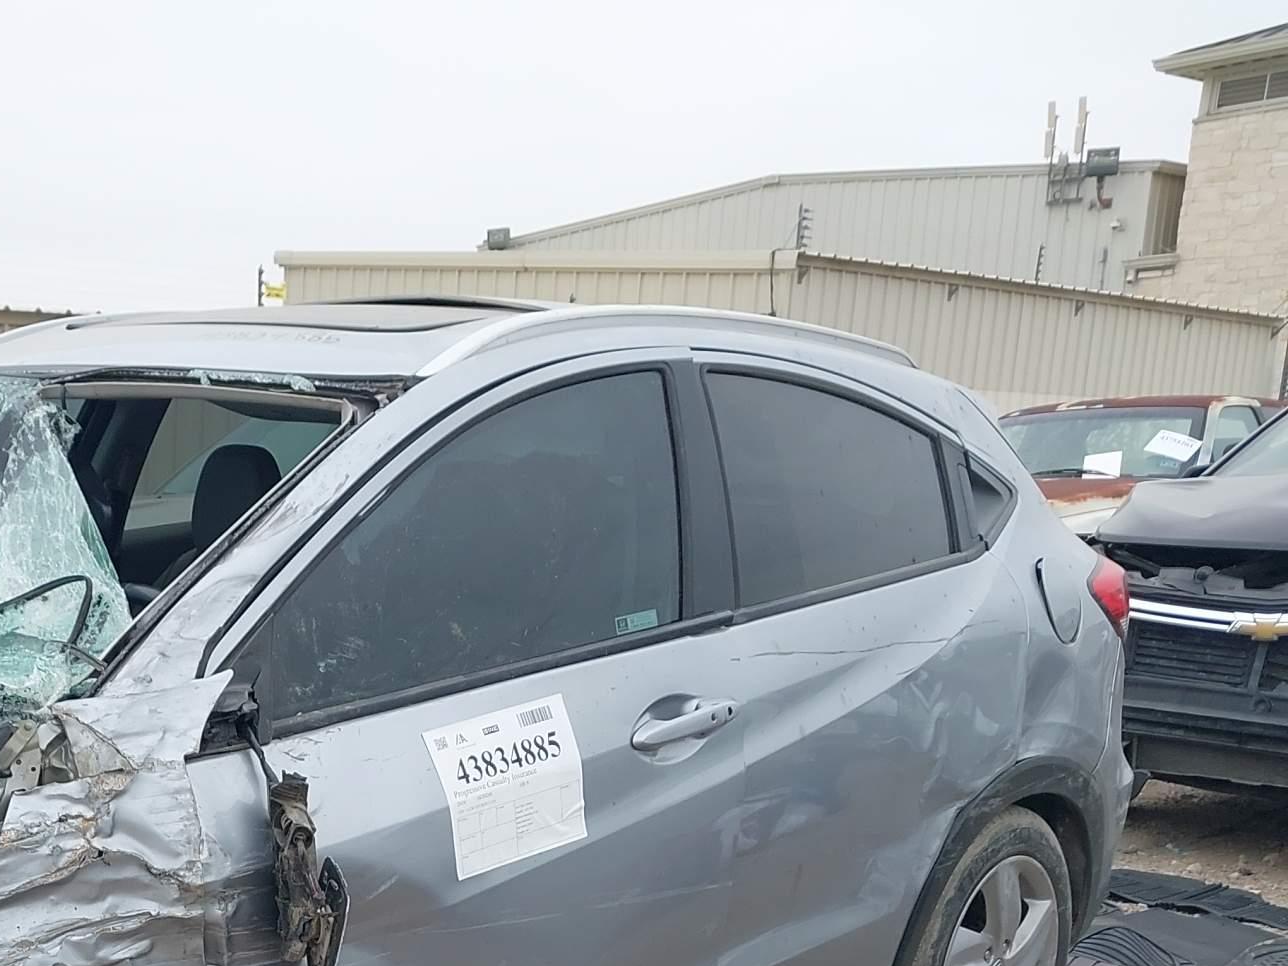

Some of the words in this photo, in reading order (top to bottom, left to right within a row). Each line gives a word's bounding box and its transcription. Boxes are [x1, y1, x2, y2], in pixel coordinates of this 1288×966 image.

[457, 731, 561, 784] 43834885
[486, 776, 510, 787] Casualty
[512, 768, 537, 781] Insurance
